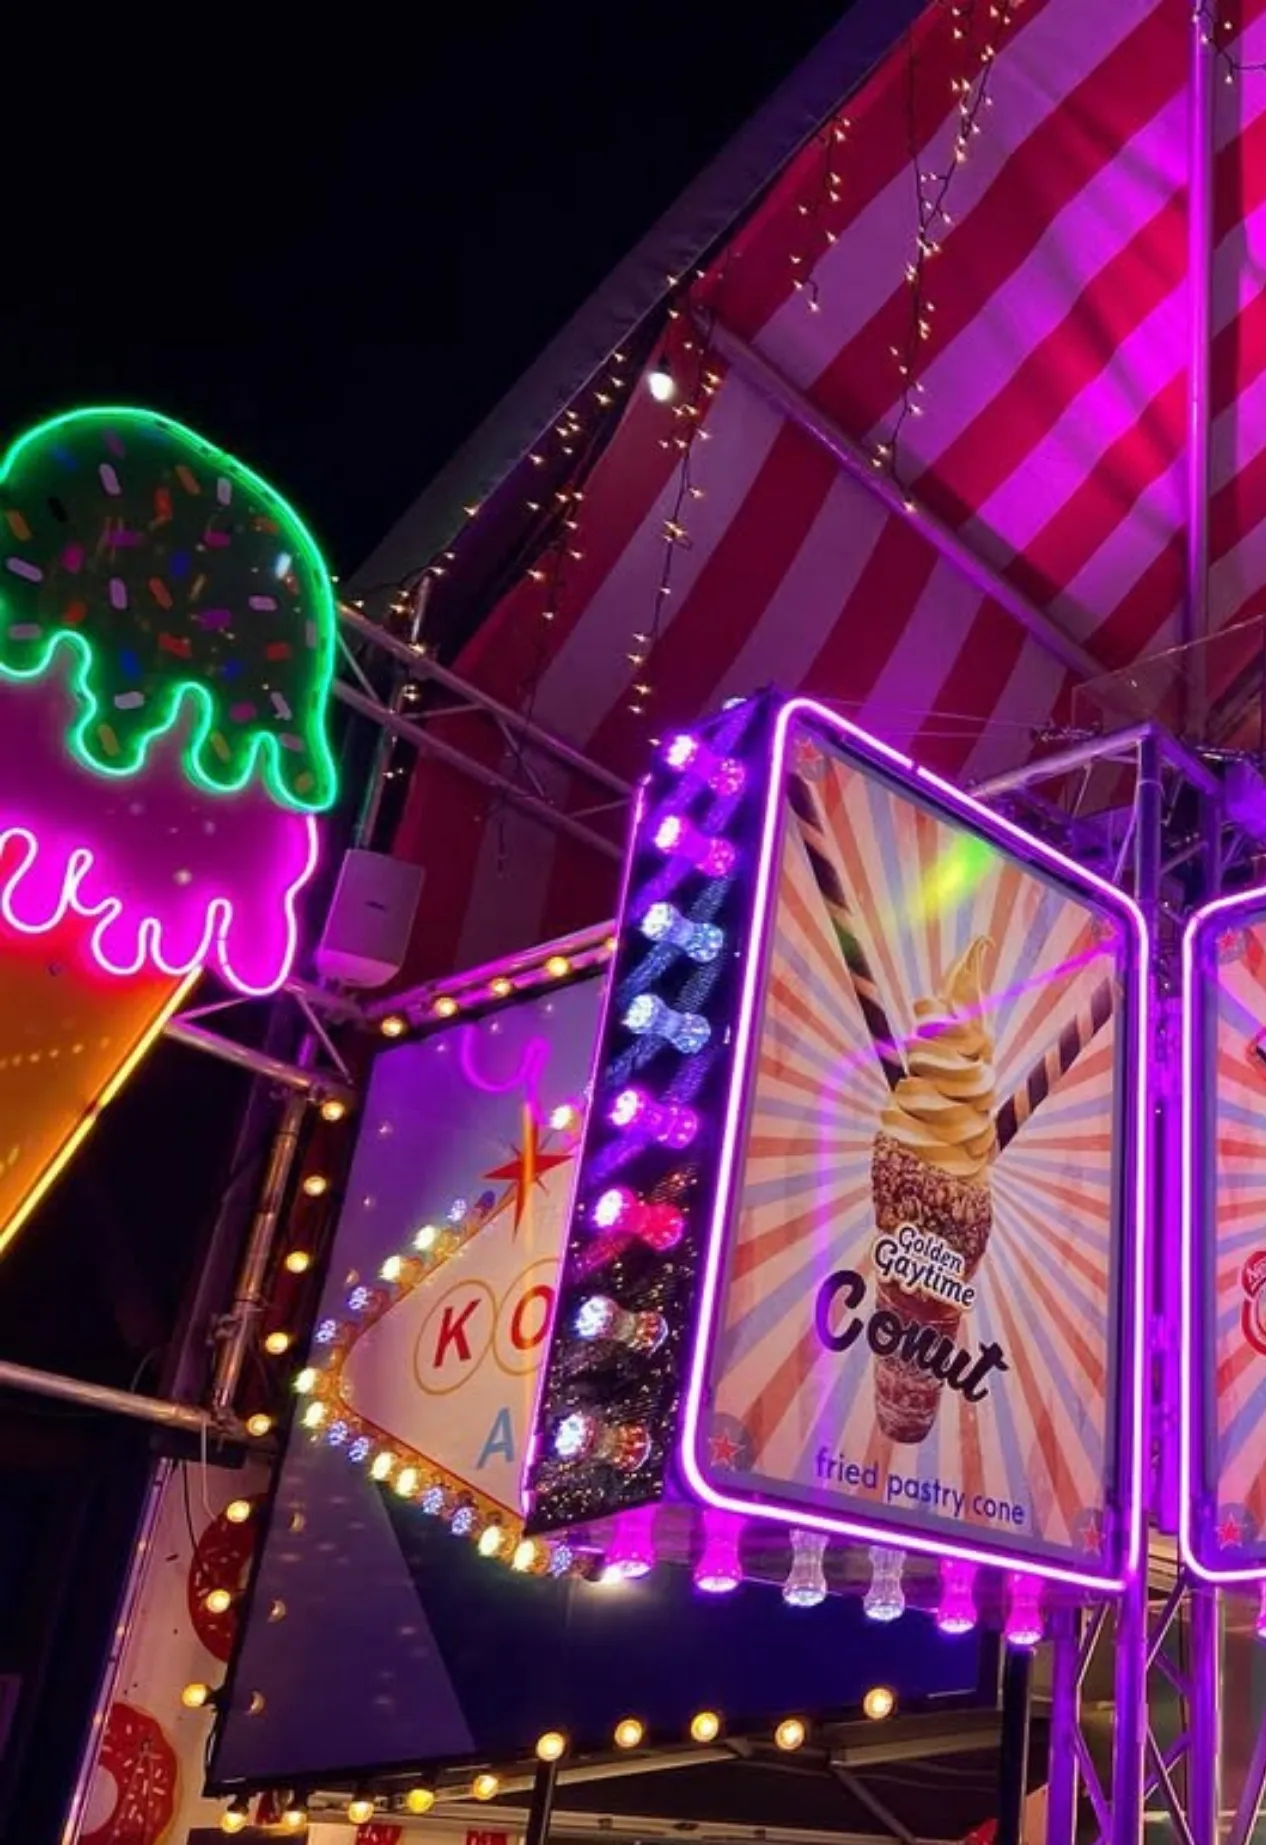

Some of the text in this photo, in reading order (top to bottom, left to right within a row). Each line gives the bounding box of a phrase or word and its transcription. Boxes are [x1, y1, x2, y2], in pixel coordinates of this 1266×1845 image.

[875, 1239, 975, 1307] Gaytime
[899, 1227, 962, 1274] Golden
[814, 1269, 1009, 1403] Conut
[816, 1448, 1025, 1526] fried pastry cone
